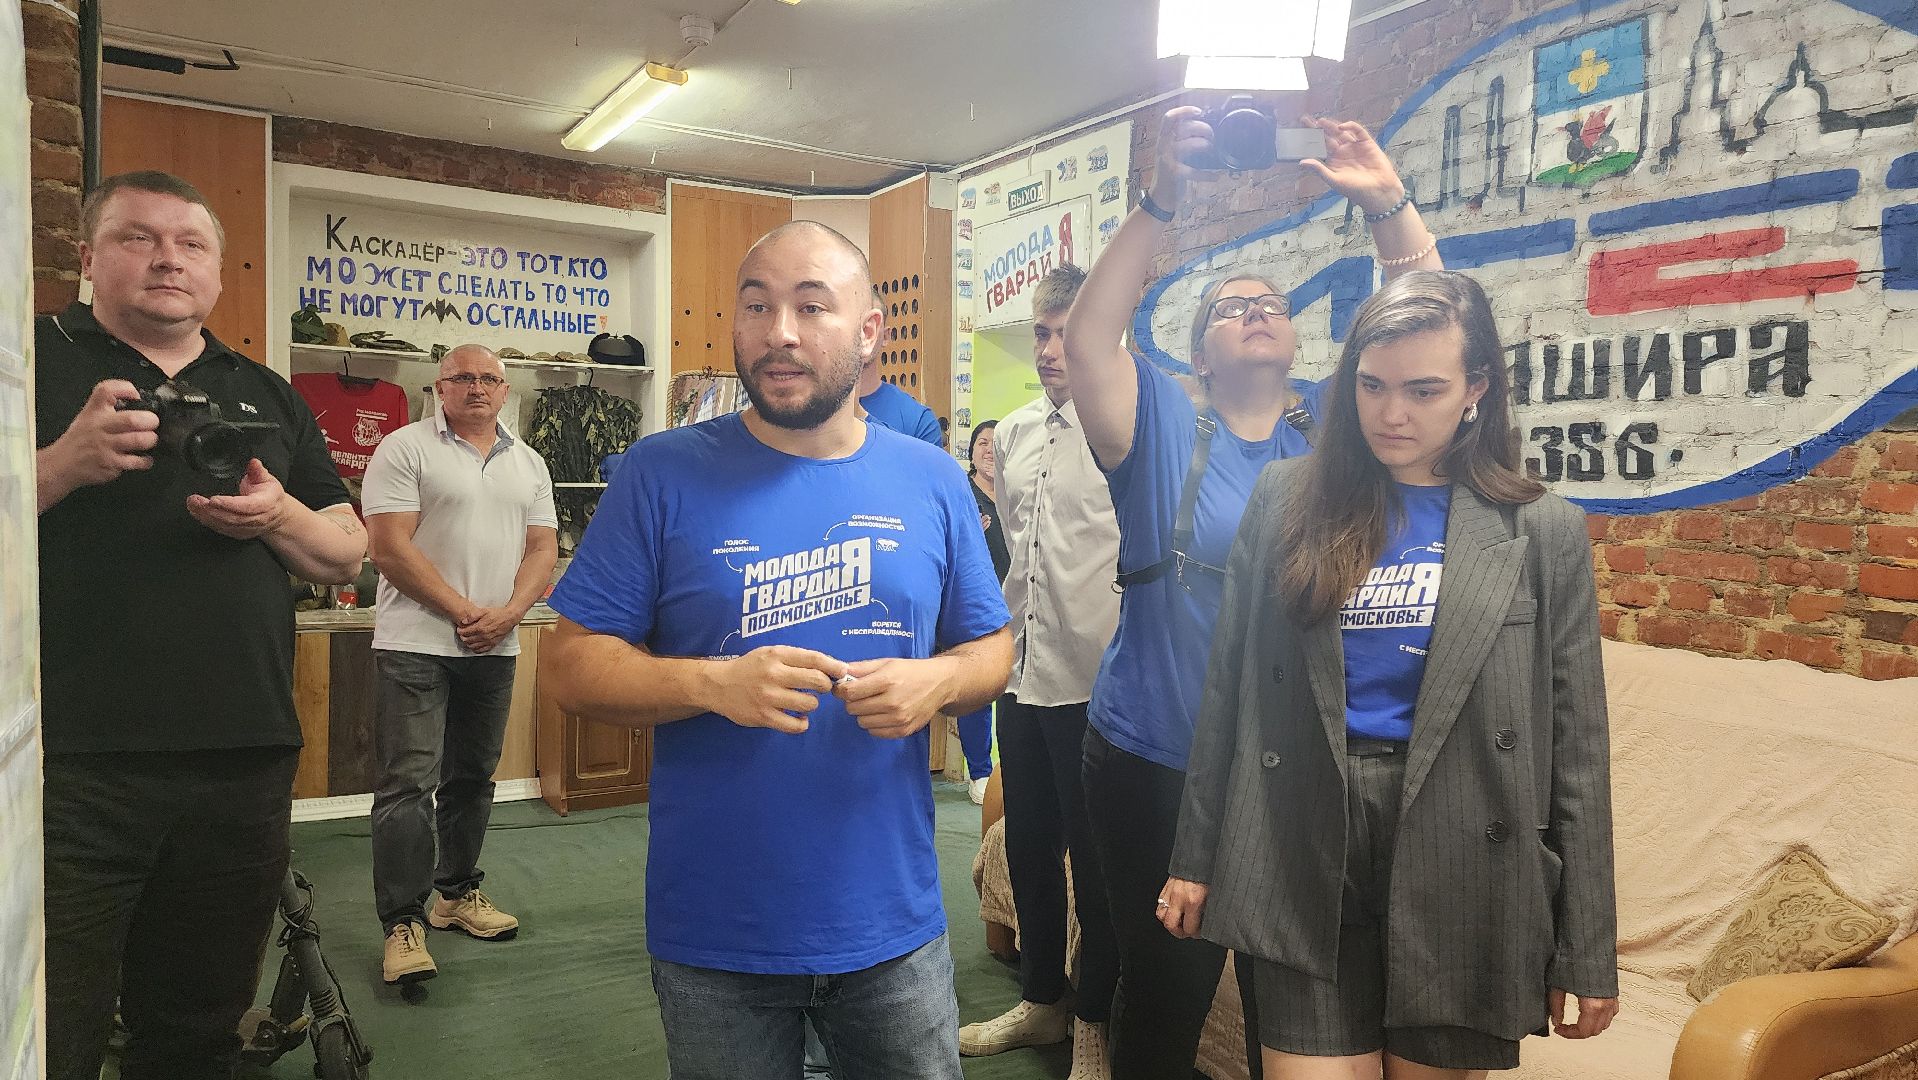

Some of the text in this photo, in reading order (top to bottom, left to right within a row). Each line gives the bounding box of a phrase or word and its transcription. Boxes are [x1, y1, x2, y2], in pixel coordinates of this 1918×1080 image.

[1011, 185, 1043, 208] ВЫХОД
[567, 257, 608, 281] КТО
[438, 271, 535, 303] СДЕЛАТЬ
[573, 287, 609, 308] ЧТО
[299, 287, 332, 314] НЕ
[340, 293, 424, 320] МОГУТ
[712, 546, 760, 555] ПОКОЛЕНИЯ
[724, 539, 750, 547] ГОЛОС
[748, 588, 863, 632] ПОДМОСКОВЬЕ
